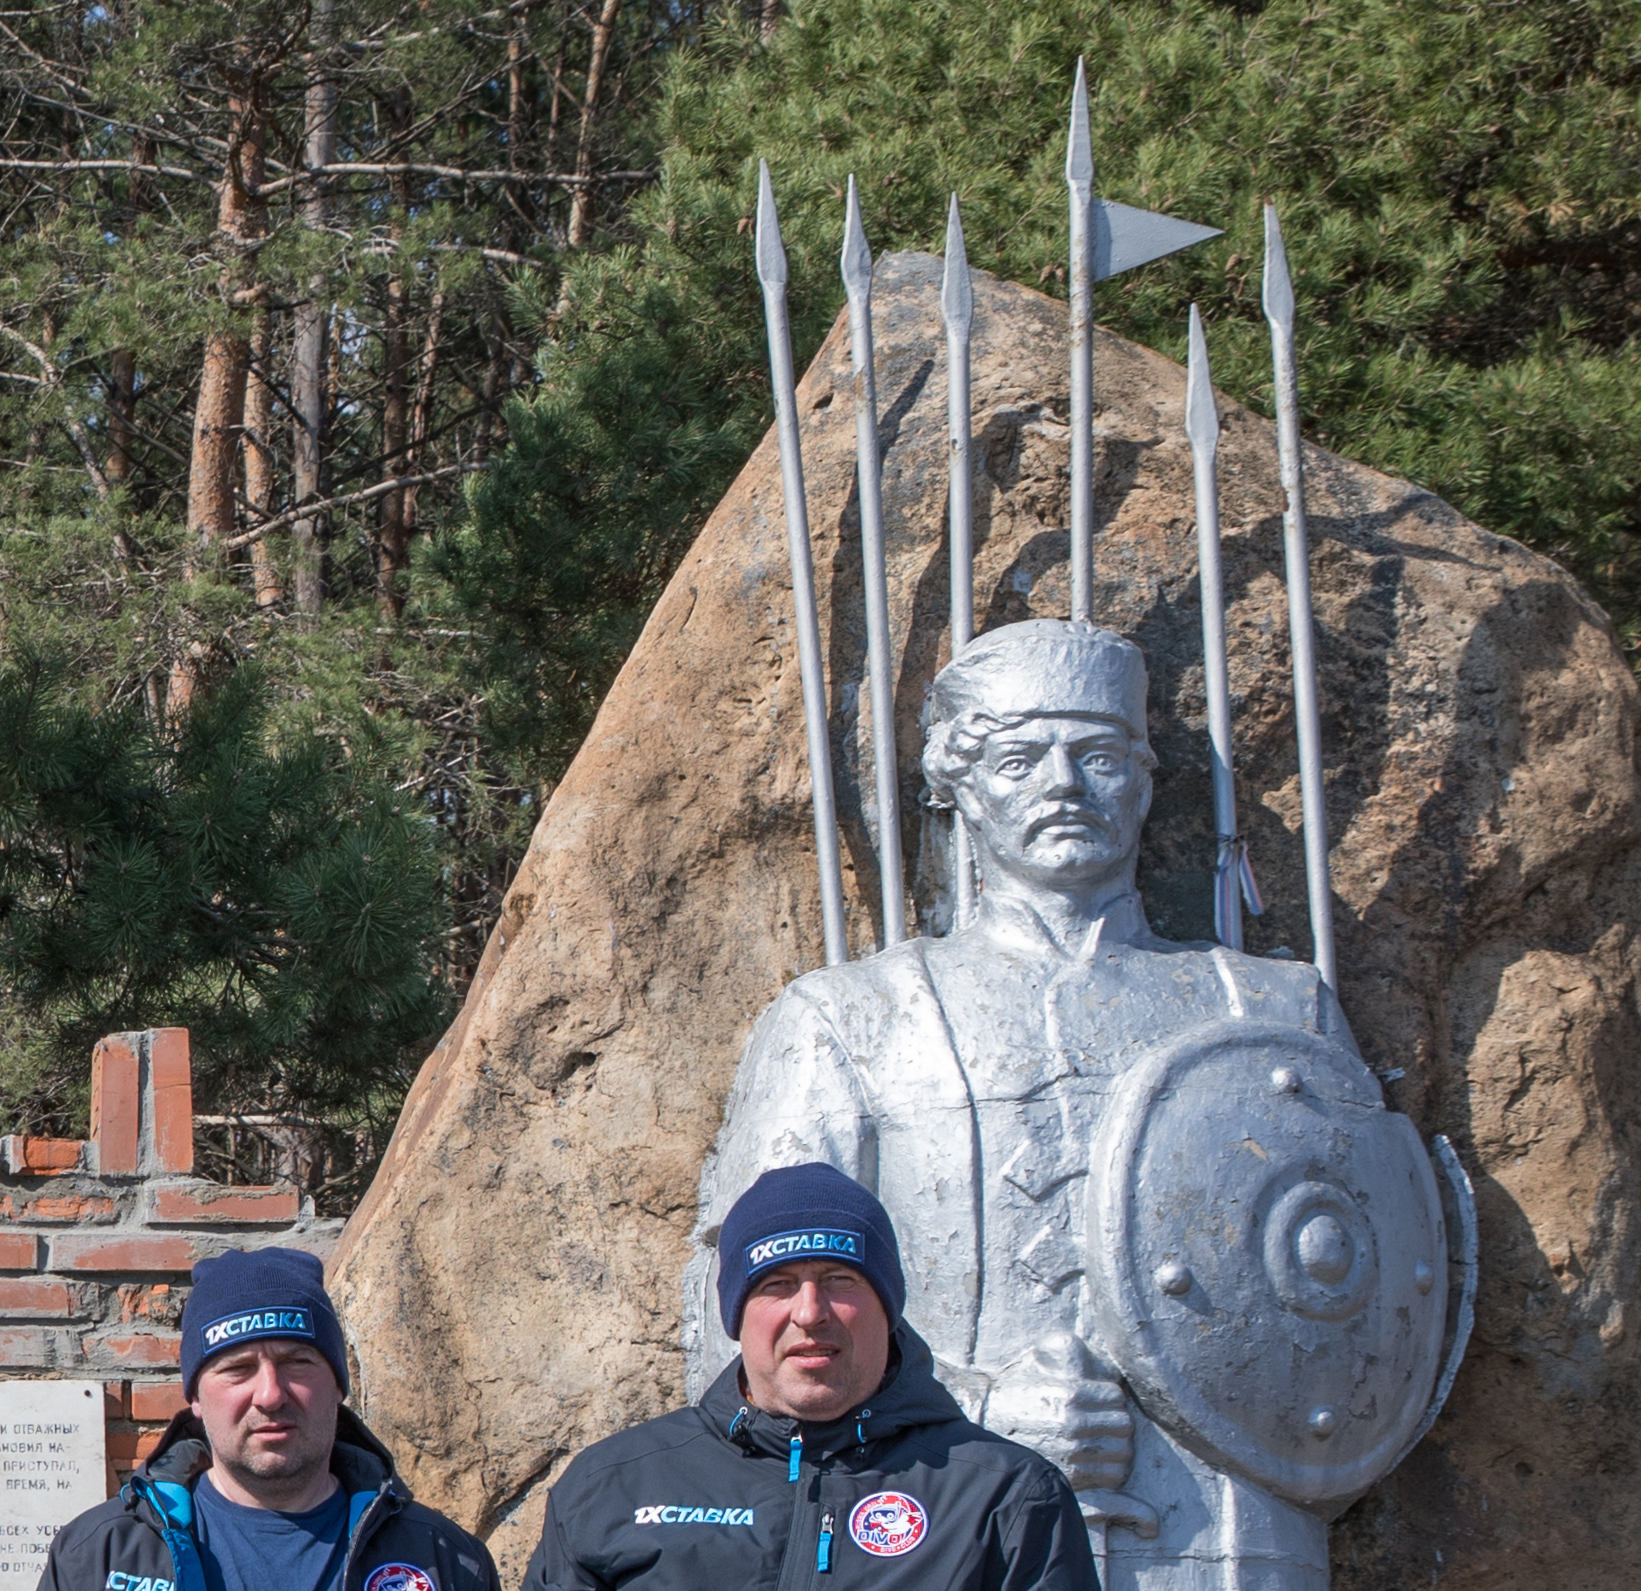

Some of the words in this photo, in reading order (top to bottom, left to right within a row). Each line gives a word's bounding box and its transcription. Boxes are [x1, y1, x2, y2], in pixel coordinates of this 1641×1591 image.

[14, 1424, 79, 1435] ОТВАЖНЫХ
[56, 1480, 72, 1490] НА
[0, 1545, 14, 1554] НЕ
